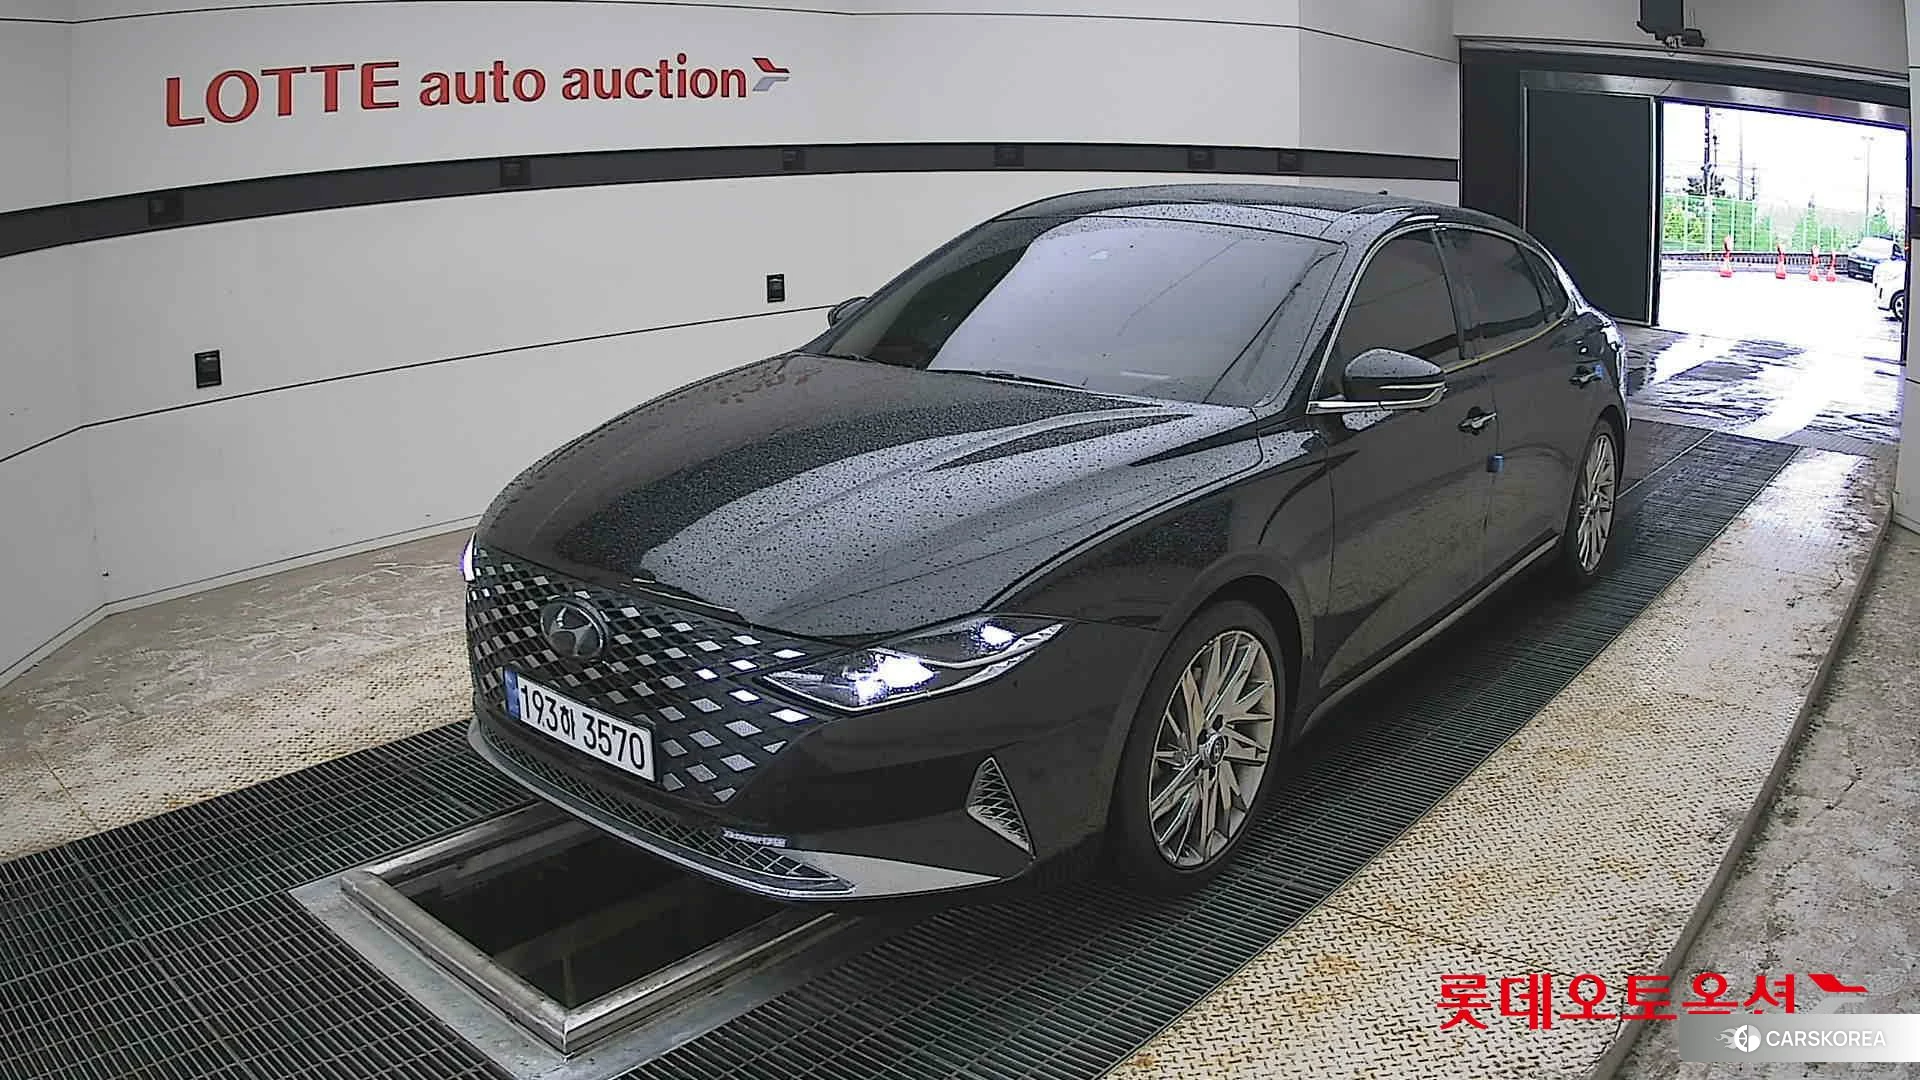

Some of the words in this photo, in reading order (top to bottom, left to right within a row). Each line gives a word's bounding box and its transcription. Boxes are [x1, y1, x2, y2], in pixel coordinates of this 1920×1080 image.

[165, 61, 400, 128] LOTTE
[418, 60, 547, 107] auto
[561, 53, 748, 100] auction
[521, 685, 576, 740] 193하
[582, 712, 646, 770] 3570
